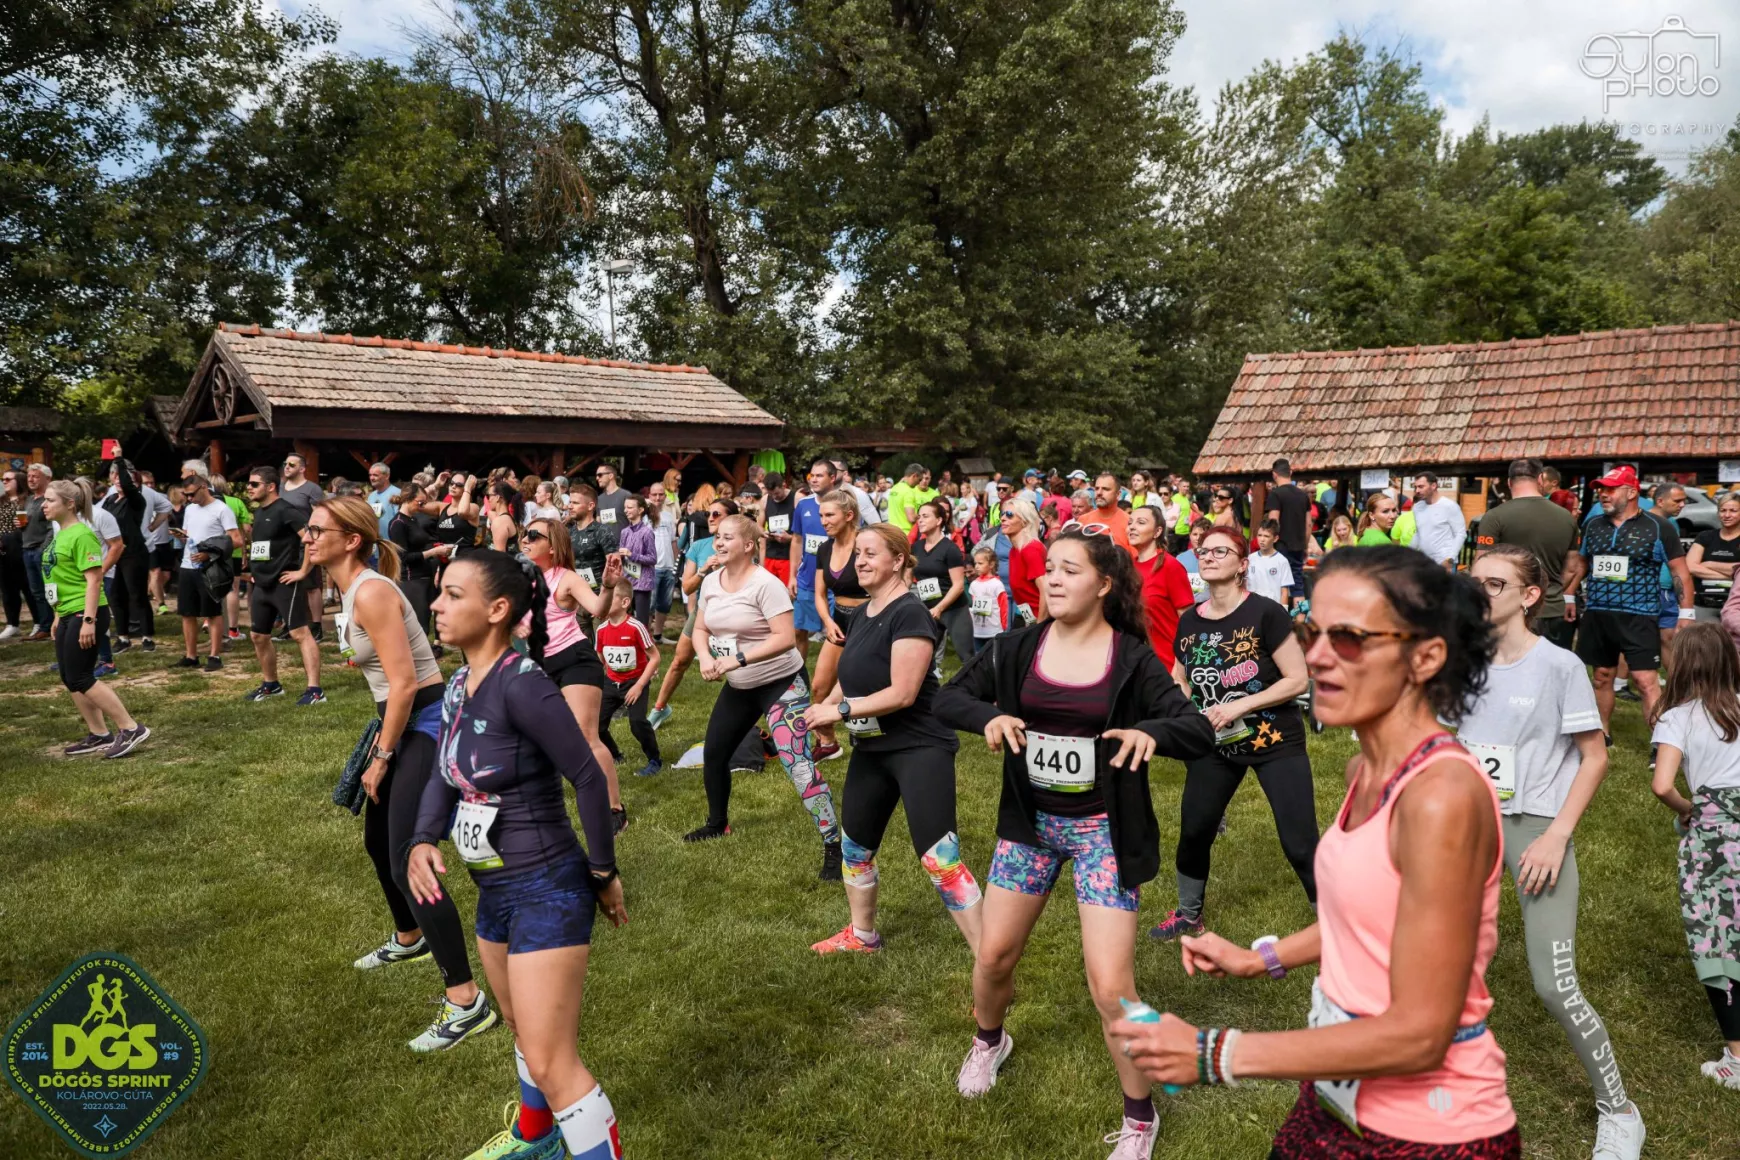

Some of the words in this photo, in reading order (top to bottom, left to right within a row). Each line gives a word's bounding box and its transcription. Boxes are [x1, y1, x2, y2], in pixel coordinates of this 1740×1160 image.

[1597, 561, 1622, 573] 590
[919, 583, 936, 596] 548
[607, 652, 631, 664] 247
[1508, 696, 1535, 707] NASA
[1033, 747, 1081, 775] 440
[457, 819, 482, 851] 168
[1552, 938, 1601, 1040] LEAGUE
[1592, 1040, 1627, 1108] GIRLS
